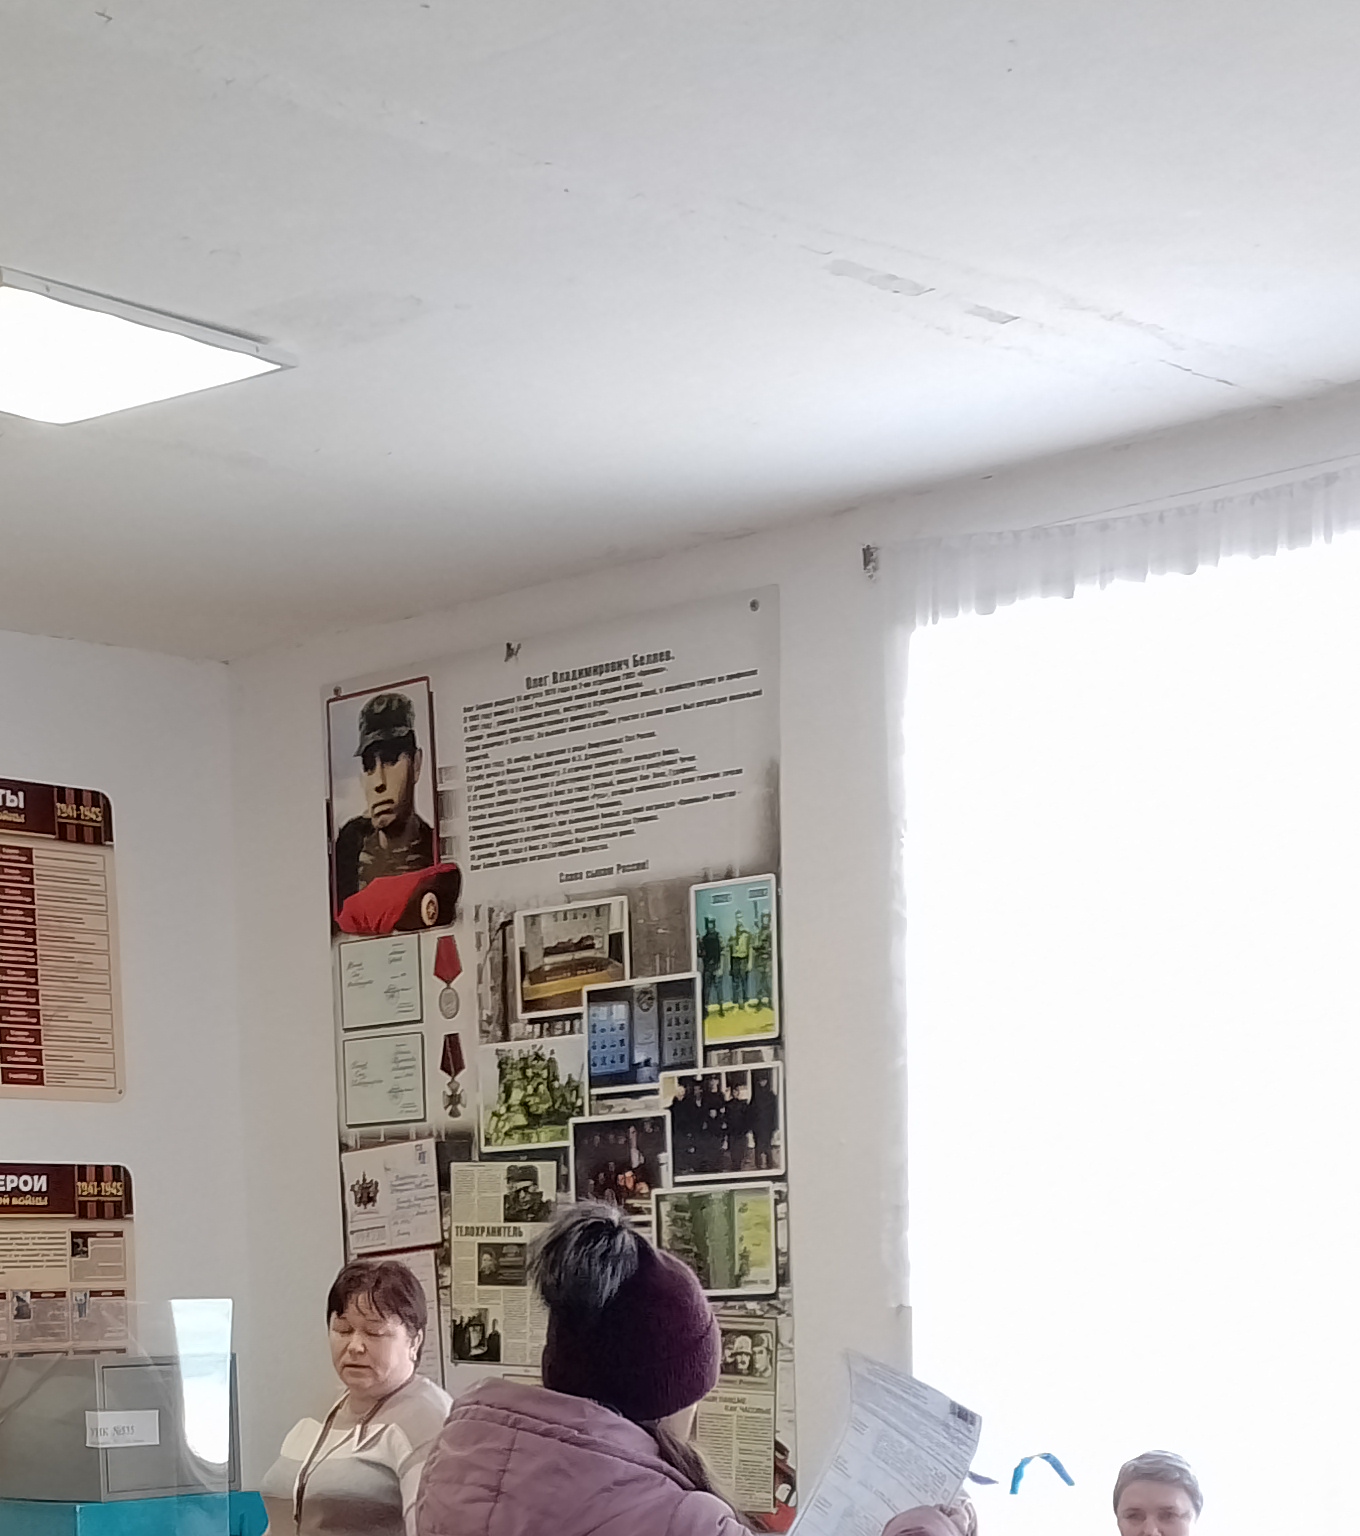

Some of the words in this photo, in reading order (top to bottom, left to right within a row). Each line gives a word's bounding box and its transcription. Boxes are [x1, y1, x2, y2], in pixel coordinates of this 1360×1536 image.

[56, 802, 102, 822] 1941-1945
[76, 1181, 123, 1196] 1941-1945
[455, 1225, 524, 1238] ТЕЛОХРАНИТЕЛЬ
